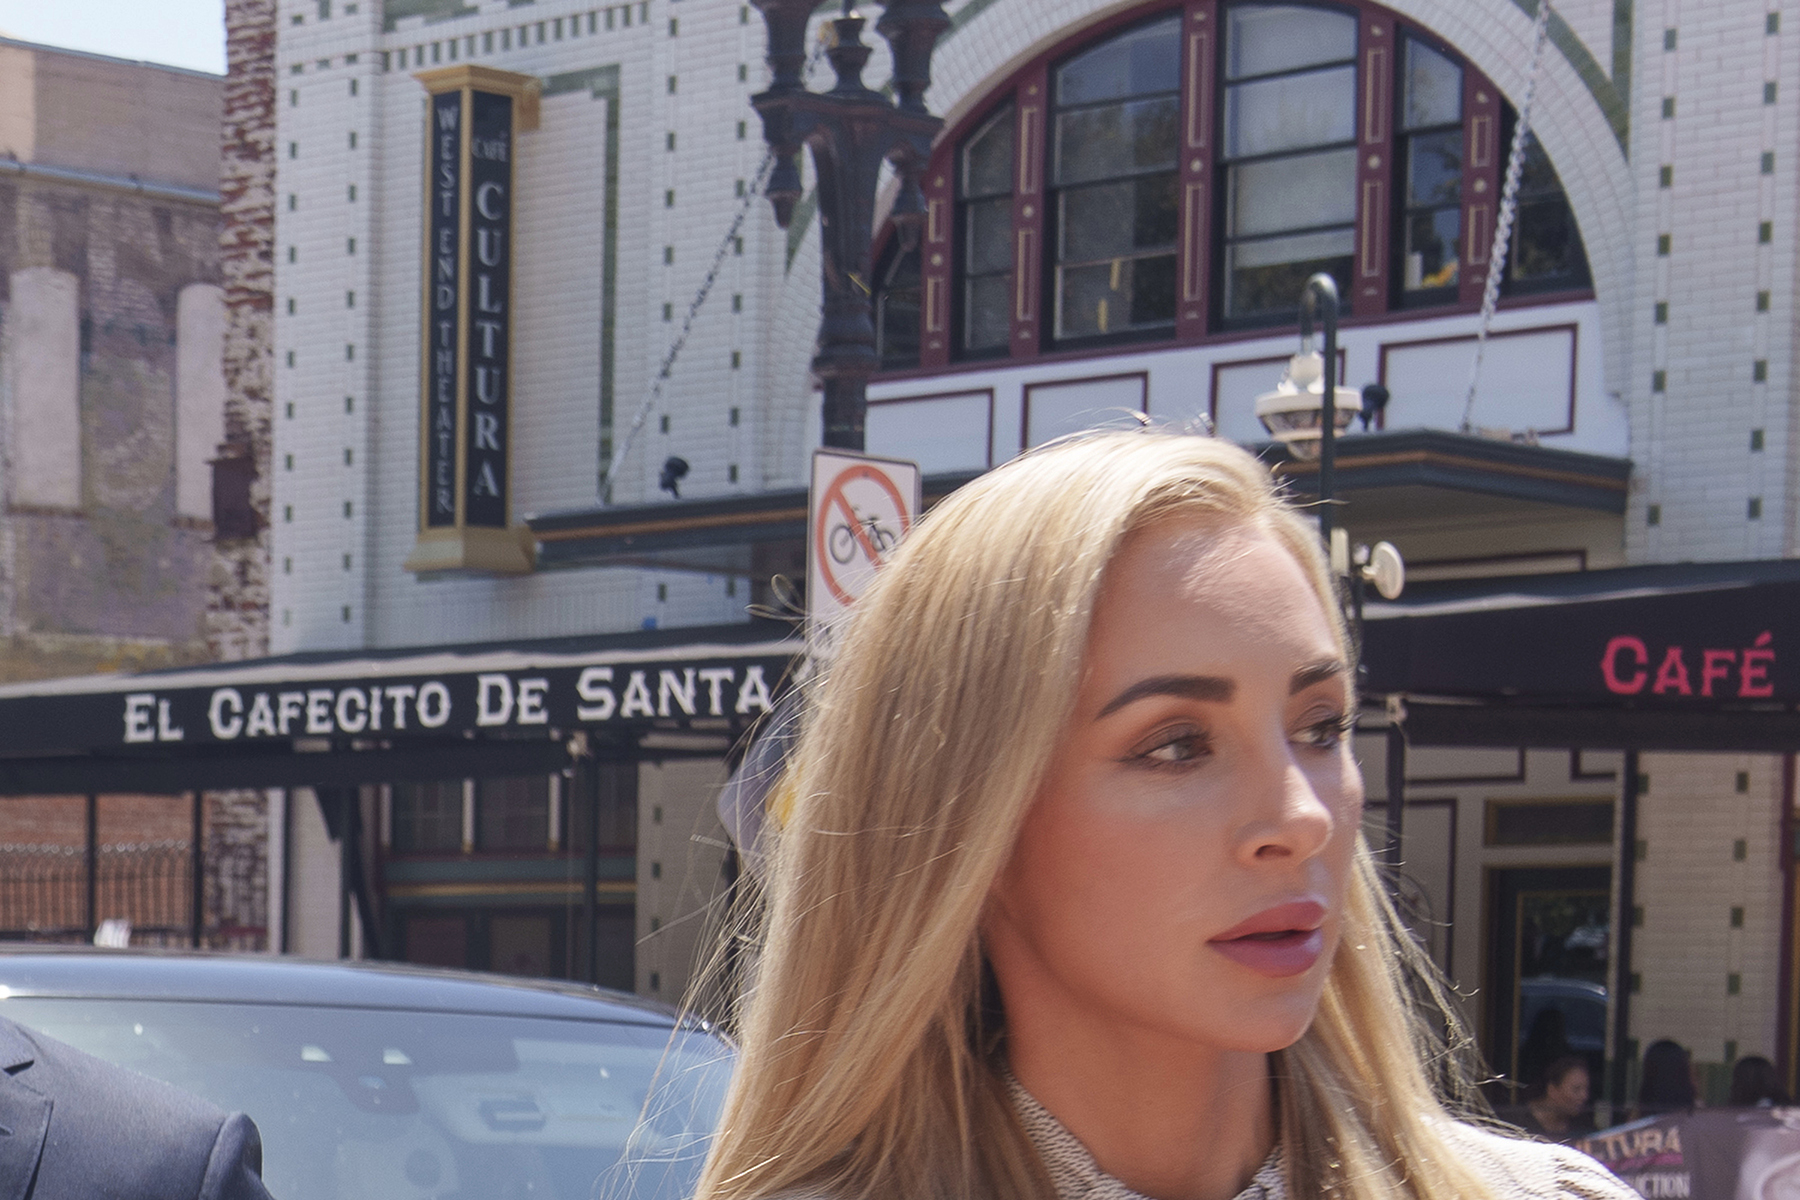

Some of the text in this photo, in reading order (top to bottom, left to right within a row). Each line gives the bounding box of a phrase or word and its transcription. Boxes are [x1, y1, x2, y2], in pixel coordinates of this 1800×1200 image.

[435, 105, 458, 514] WEST END THEATER
[473, 180, 504, 498] CULTURA
[122, 665, 775, 743] EL CAFECITO DE SANTA
[1600, 629, 1776, 698] CAFÉ
